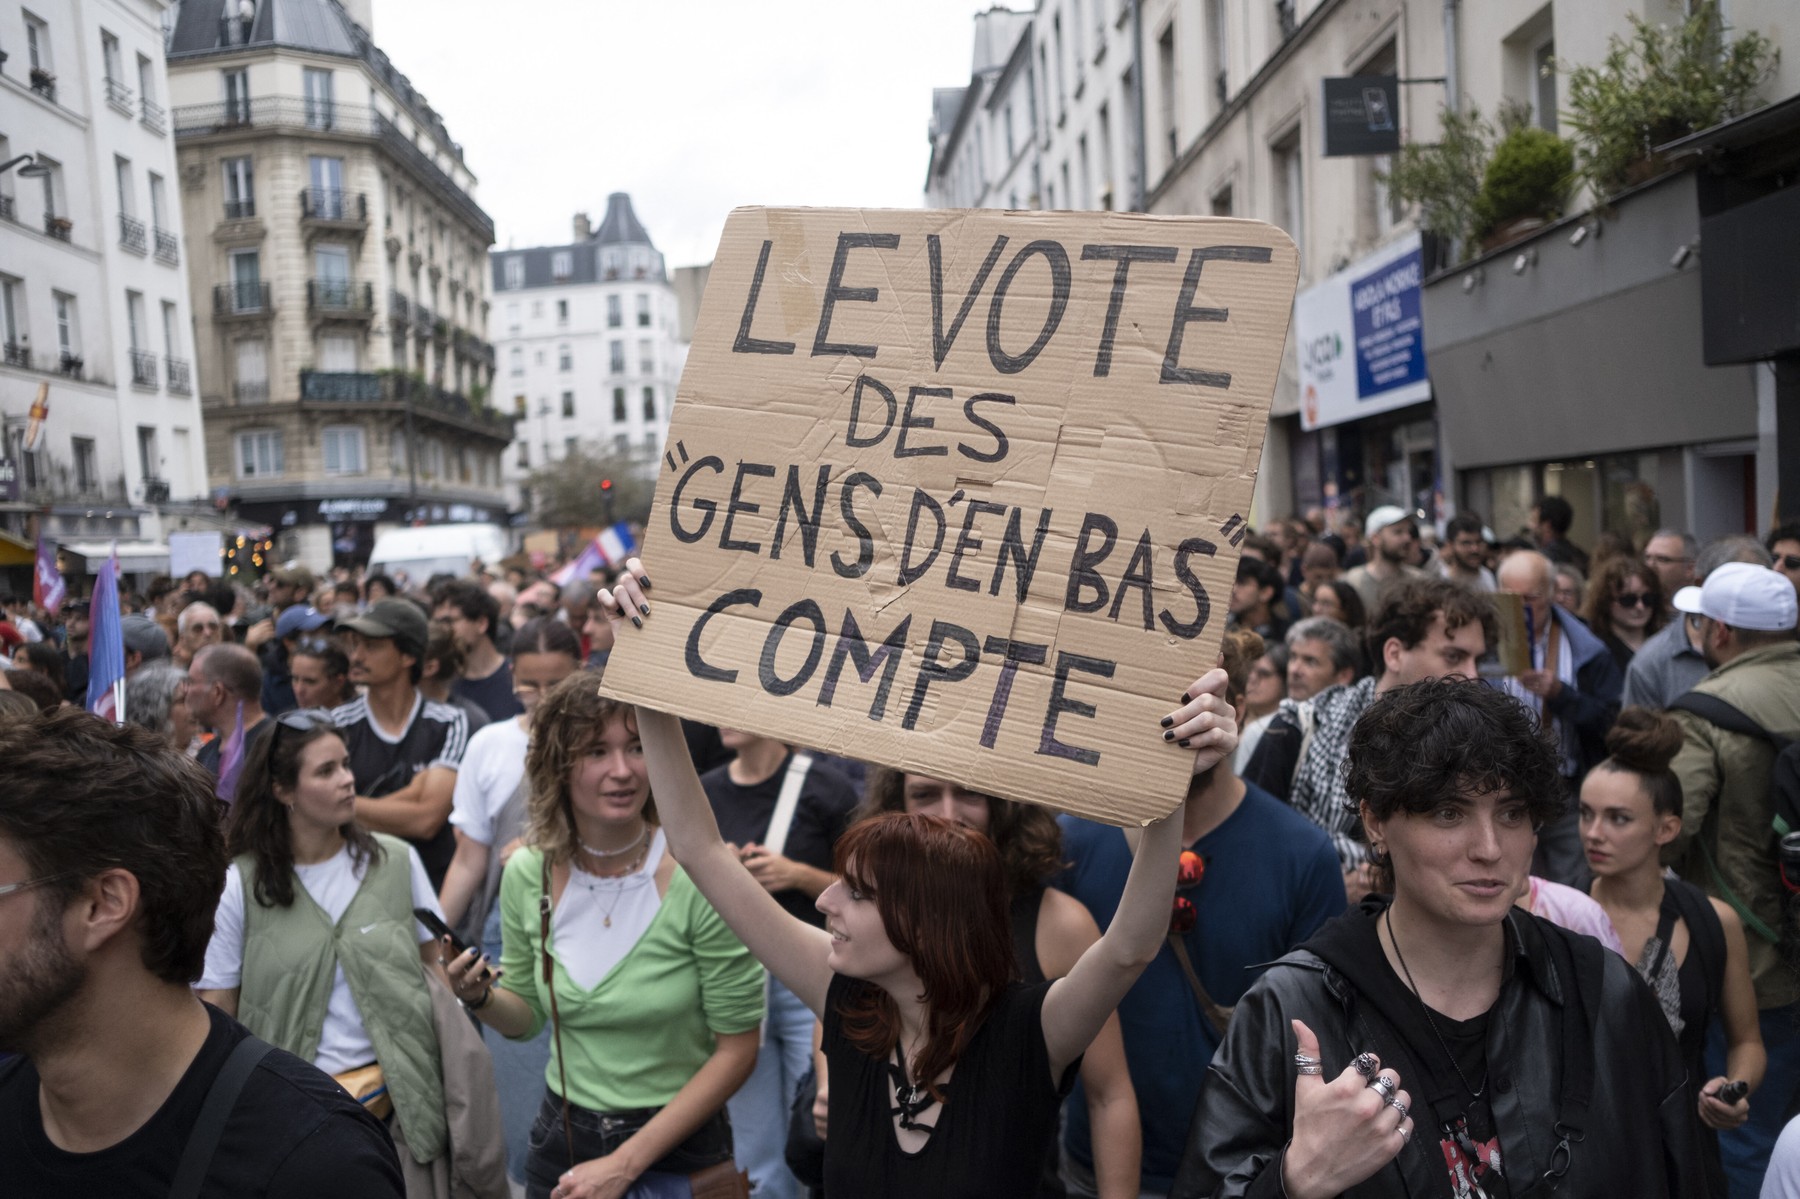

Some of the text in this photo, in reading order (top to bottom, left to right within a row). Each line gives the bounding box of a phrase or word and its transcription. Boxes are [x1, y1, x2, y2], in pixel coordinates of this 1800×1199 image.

[731, 231, 1274, 390] LE VOTE
[844, 374, 1017, 464] DES
[664, 440, 1248, 641] "GENS D'EN BAS"
[683, 588, 1118, 768] COMPTE
